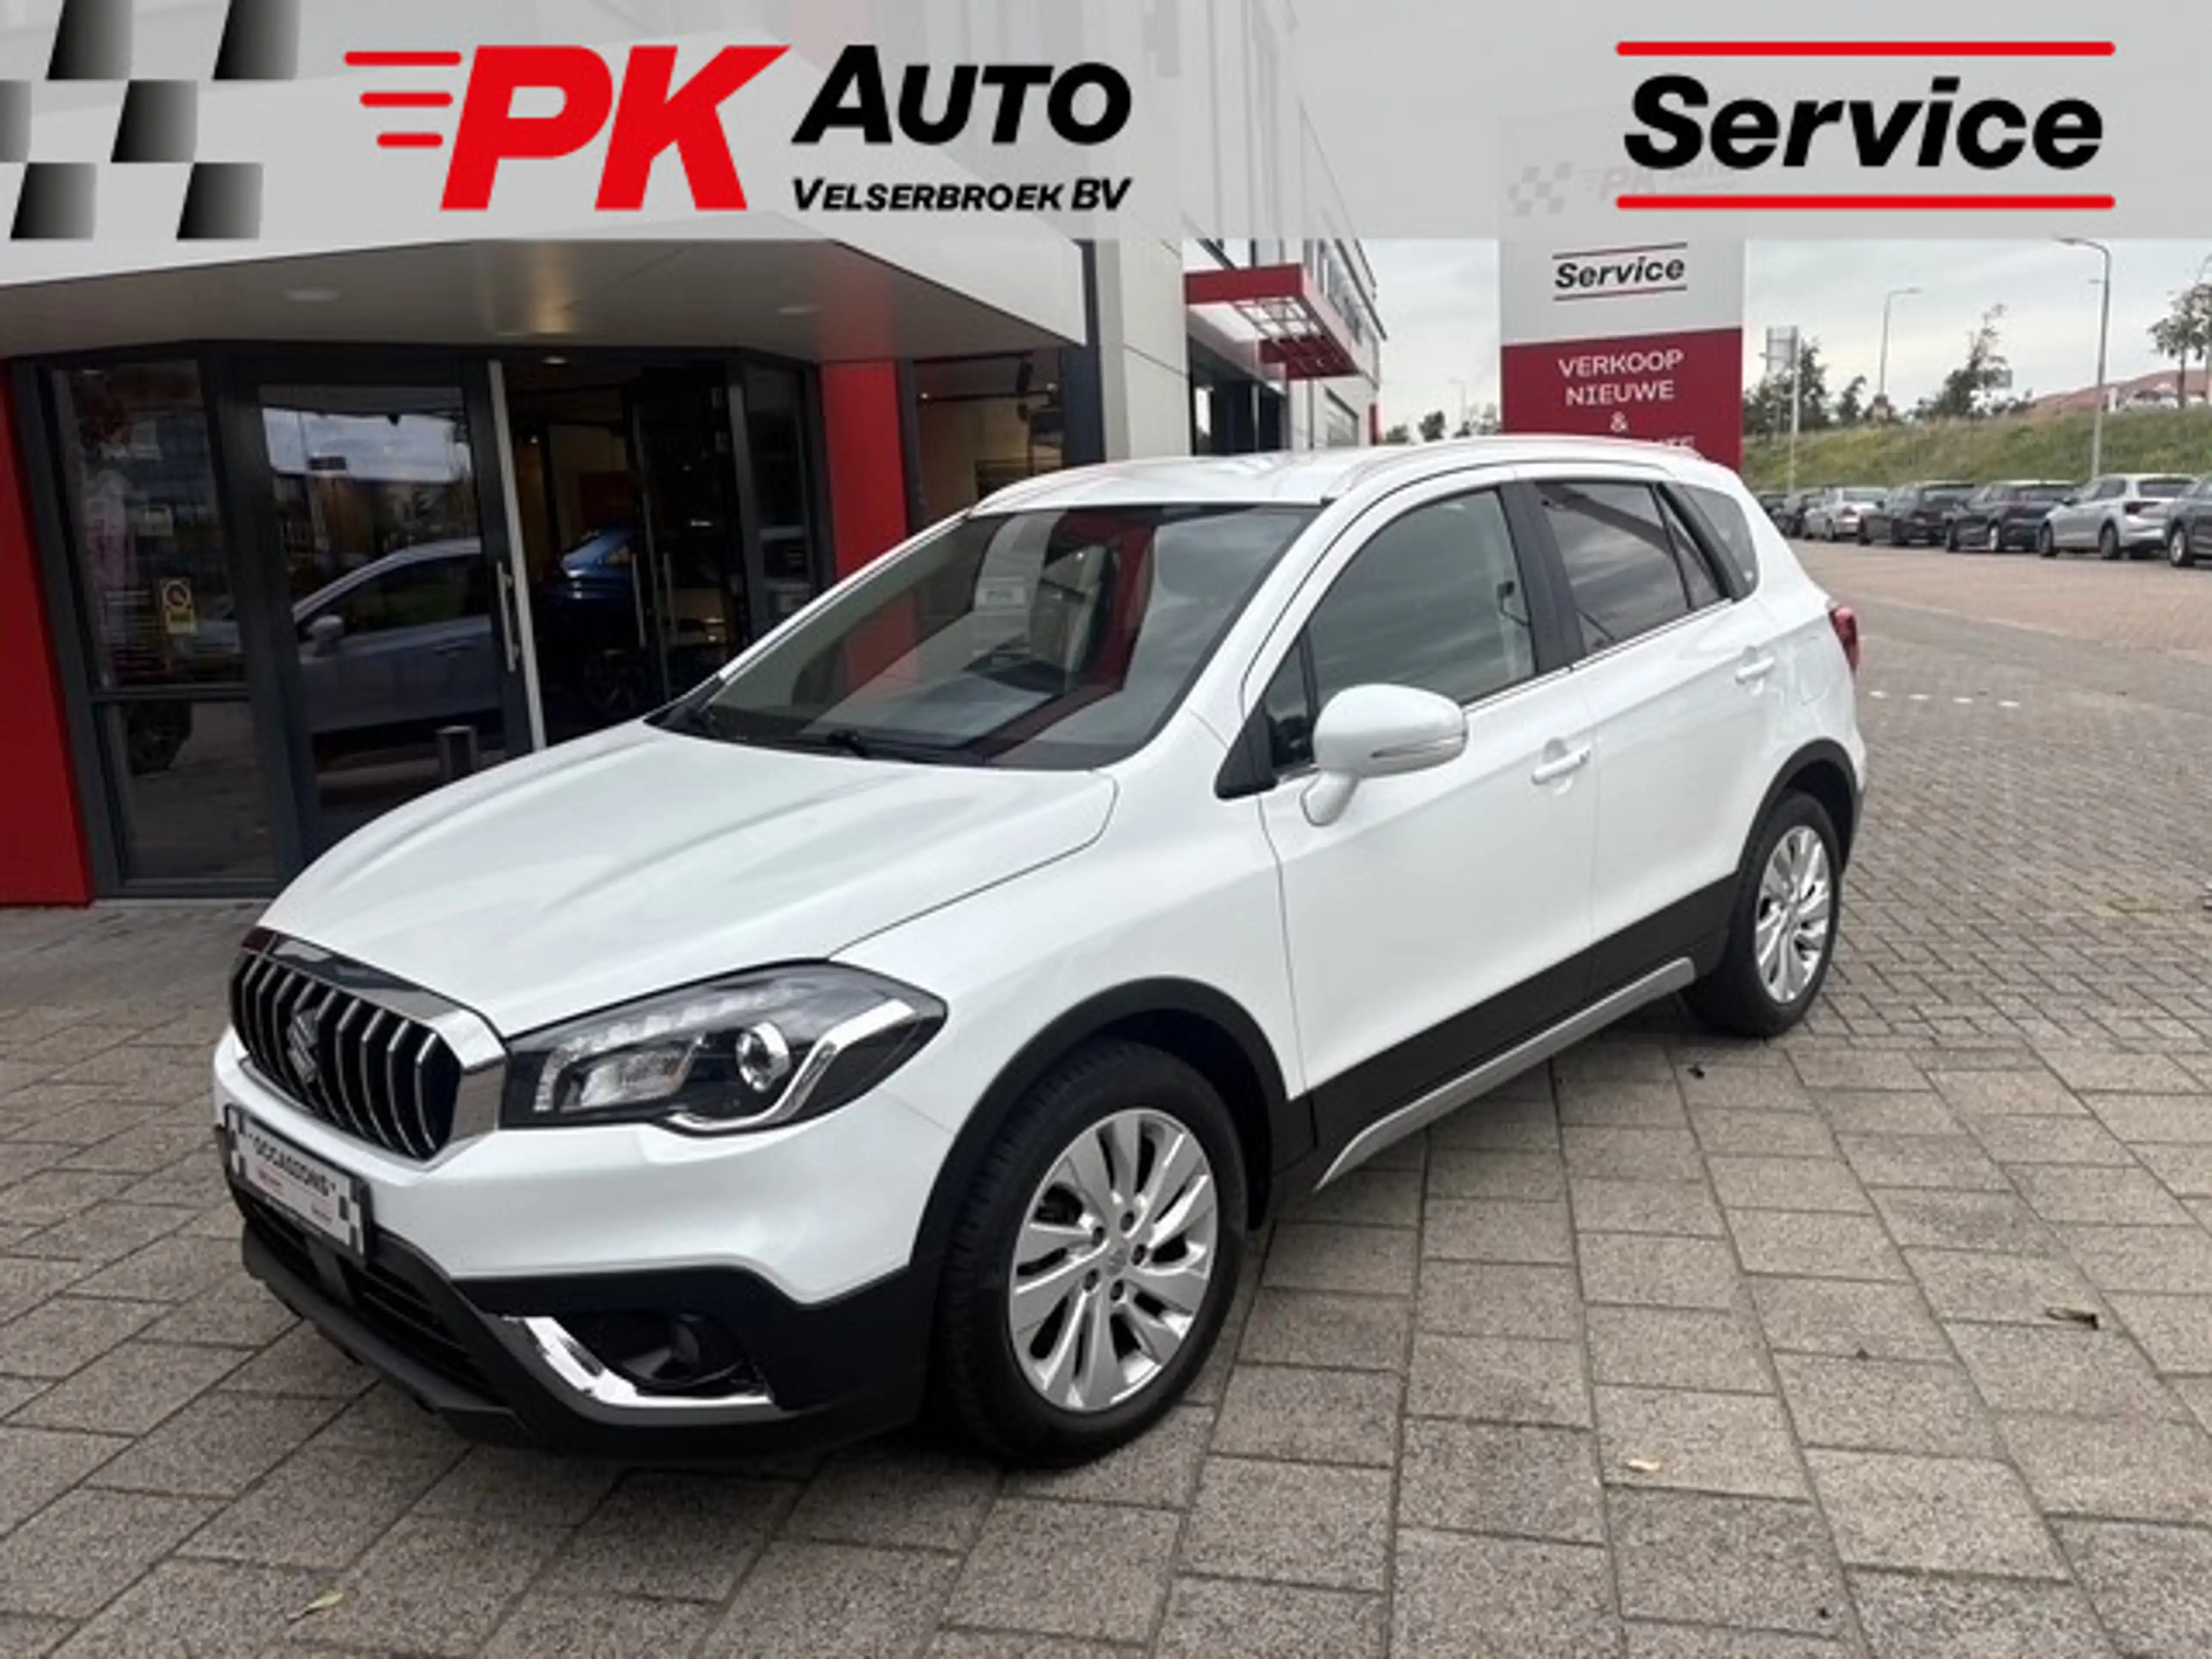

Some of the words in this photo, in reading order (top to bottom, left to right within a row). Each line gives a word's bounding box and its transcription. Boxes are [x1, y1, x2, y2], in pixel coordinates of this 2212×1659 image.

[1555, 256, 1685, 289] Service
[1558, 349, 1684, 378] VERKOOP
[1565, 380, 1675, 406] NIEUWE
[1610, 411, 1628, 433] &
